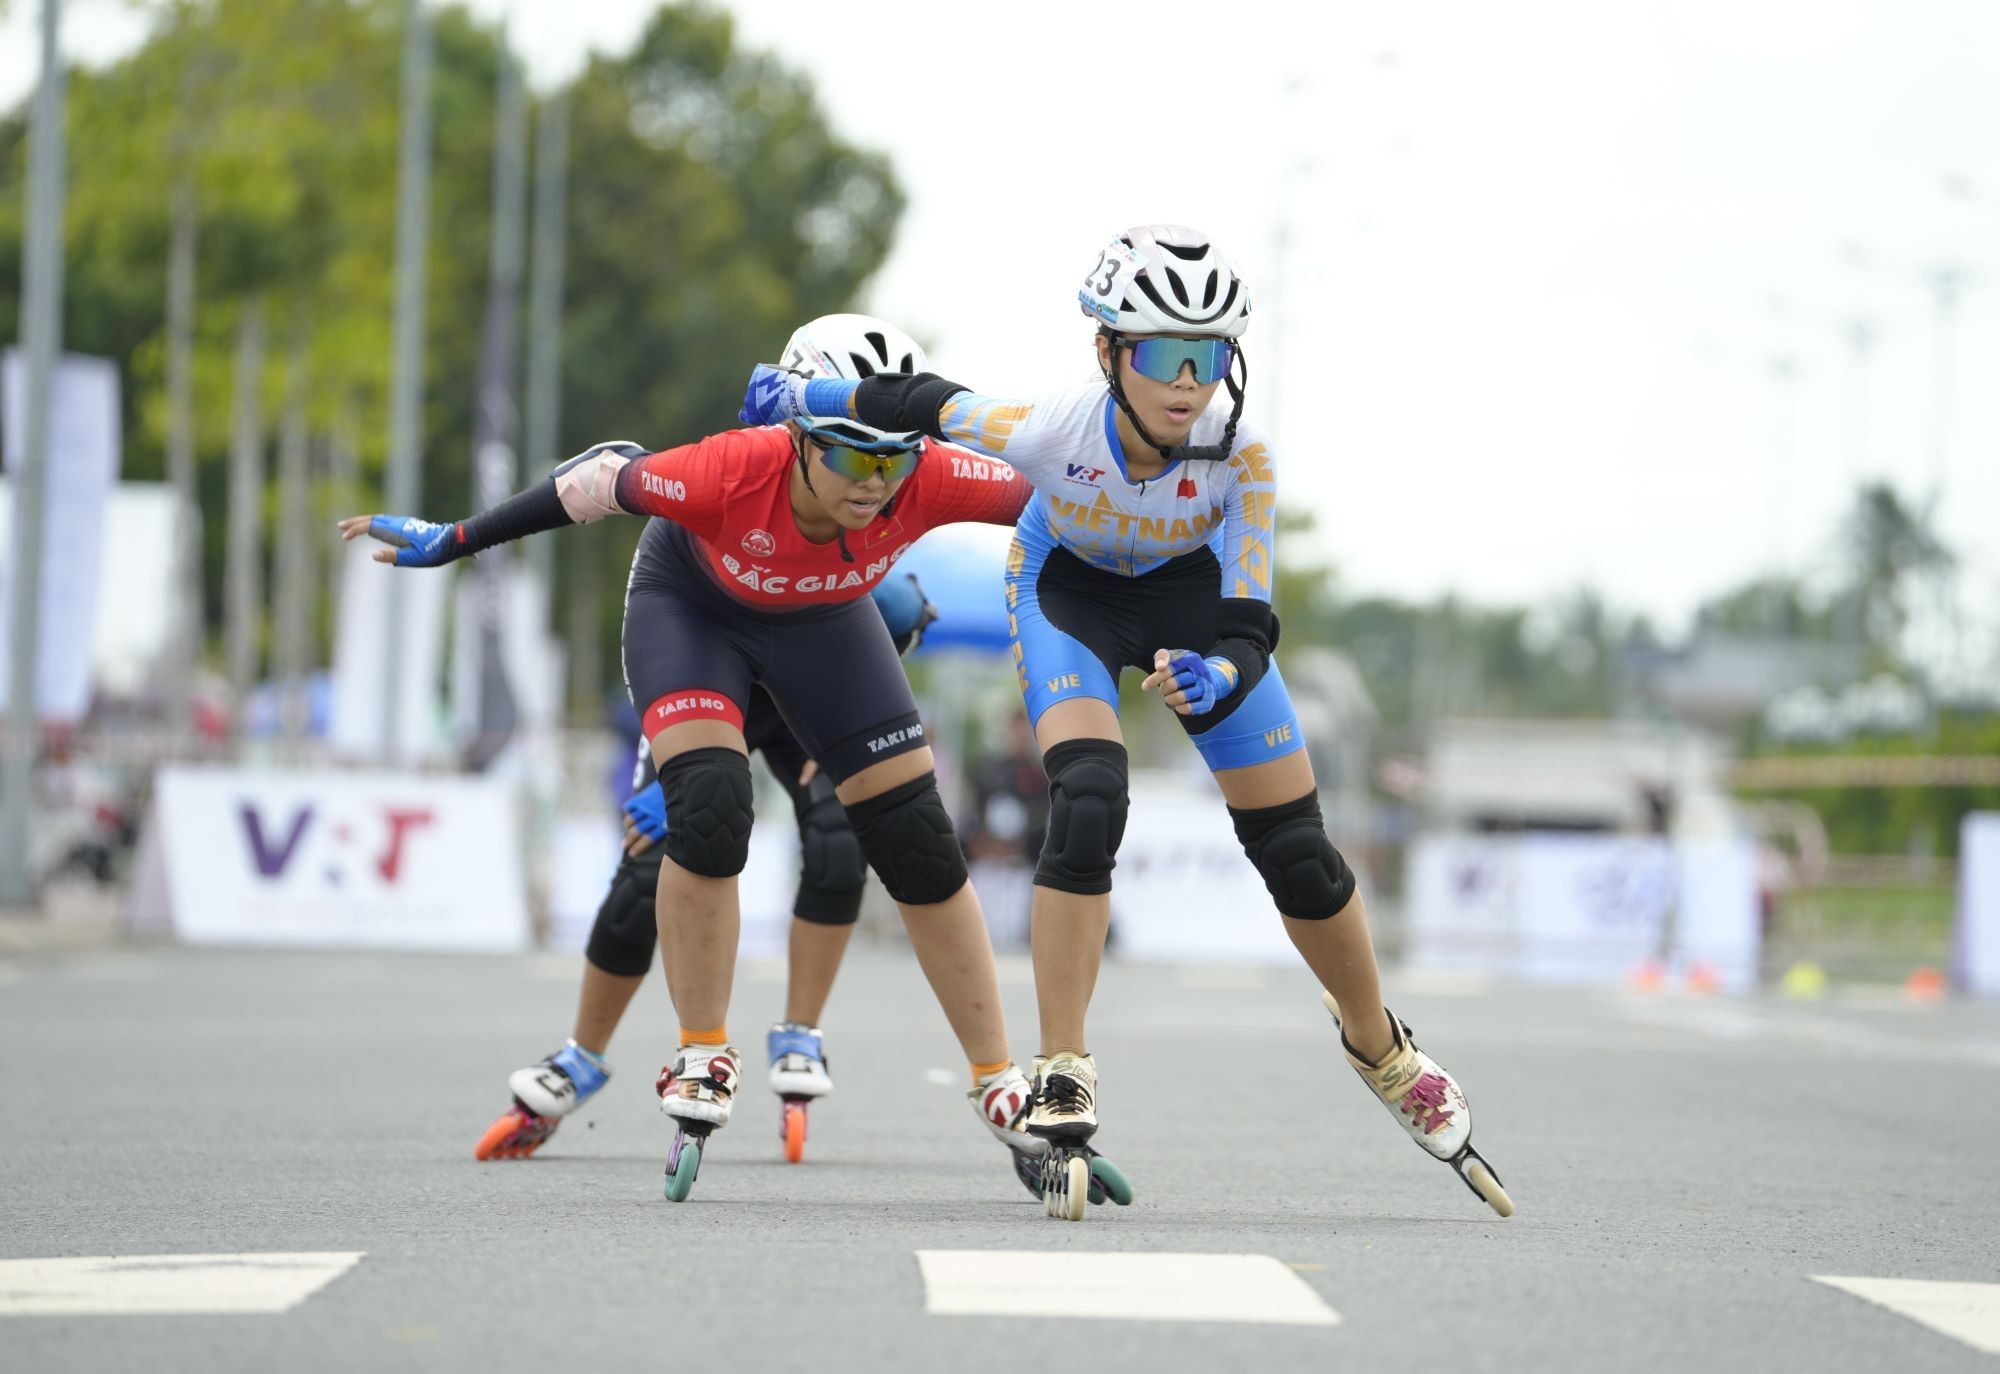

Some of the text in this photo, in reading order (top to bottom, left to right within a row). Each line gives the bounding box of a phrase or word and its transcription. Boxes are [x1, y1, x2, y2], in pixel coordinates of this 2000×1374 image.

[1085, 250, 1121, 297] 23
[1067, 463, 1106, 482] VRT
[1051, 494, 1224, 543] VIETNAM
[722, 553, 789, 594] BẮC
[1047, 673, 1082, 693] VIE
[1264, 724, 1292, 748] VIE
